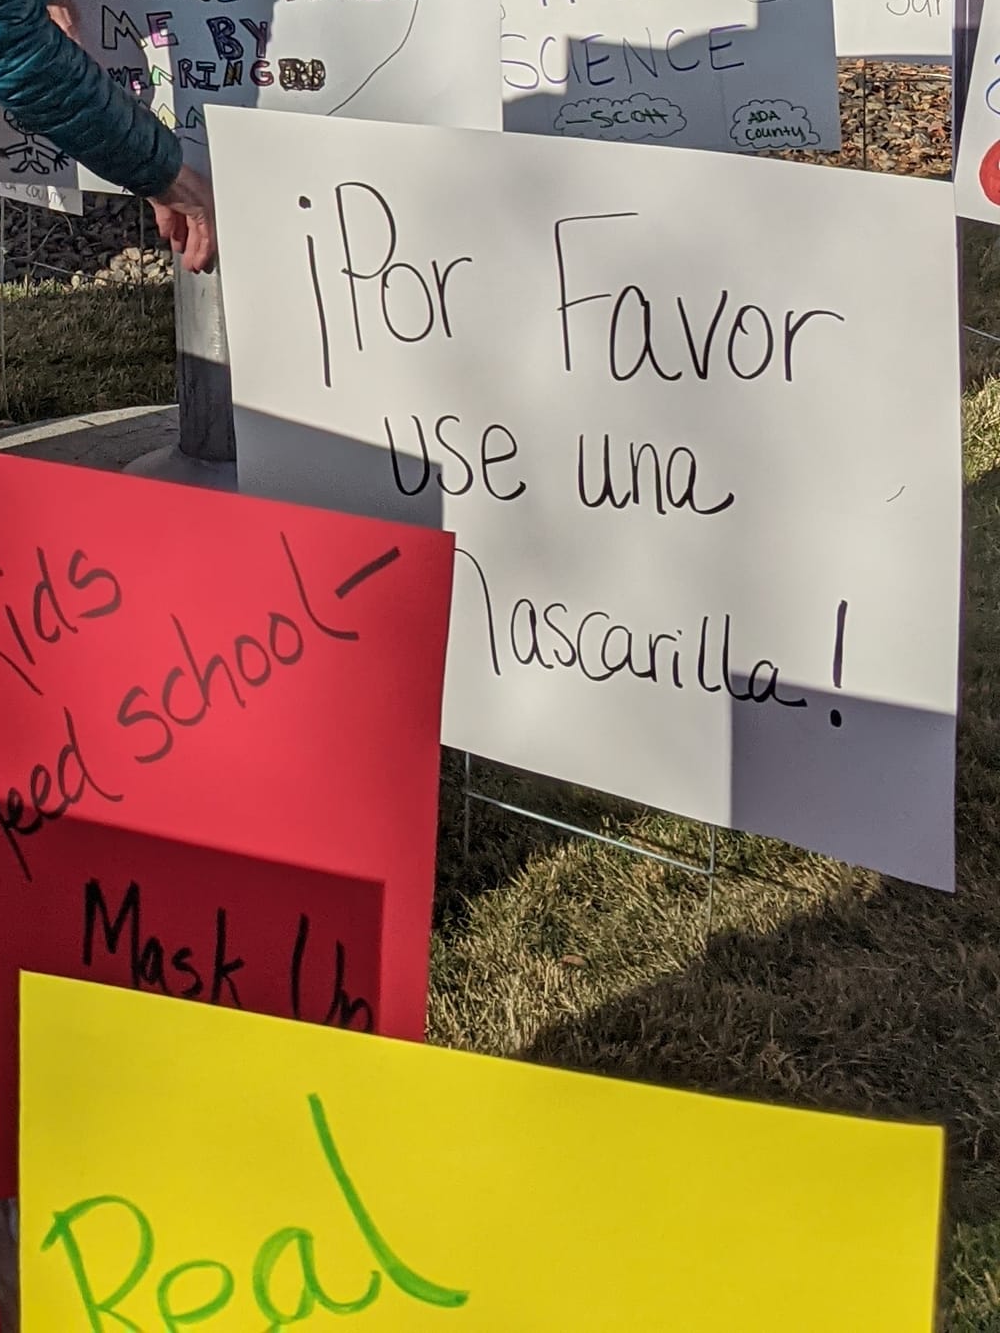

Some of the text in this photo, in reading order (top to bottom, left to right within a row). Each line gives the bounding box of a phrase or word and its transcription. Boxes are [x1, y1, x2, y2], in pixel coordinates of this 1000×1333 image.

[100, 3, 270, 60] ME BY
[502, 25, 748, 91] SCIENCE
[107, 59, 274, 92] WEARING
[748, 110, 781, 125] ADA
[555, 210, 845, 383] Favor
[577, 432, 735, 516] una
[82, 877, 248, 1010] Mask
[37, 1093, 471, 1333] Real
